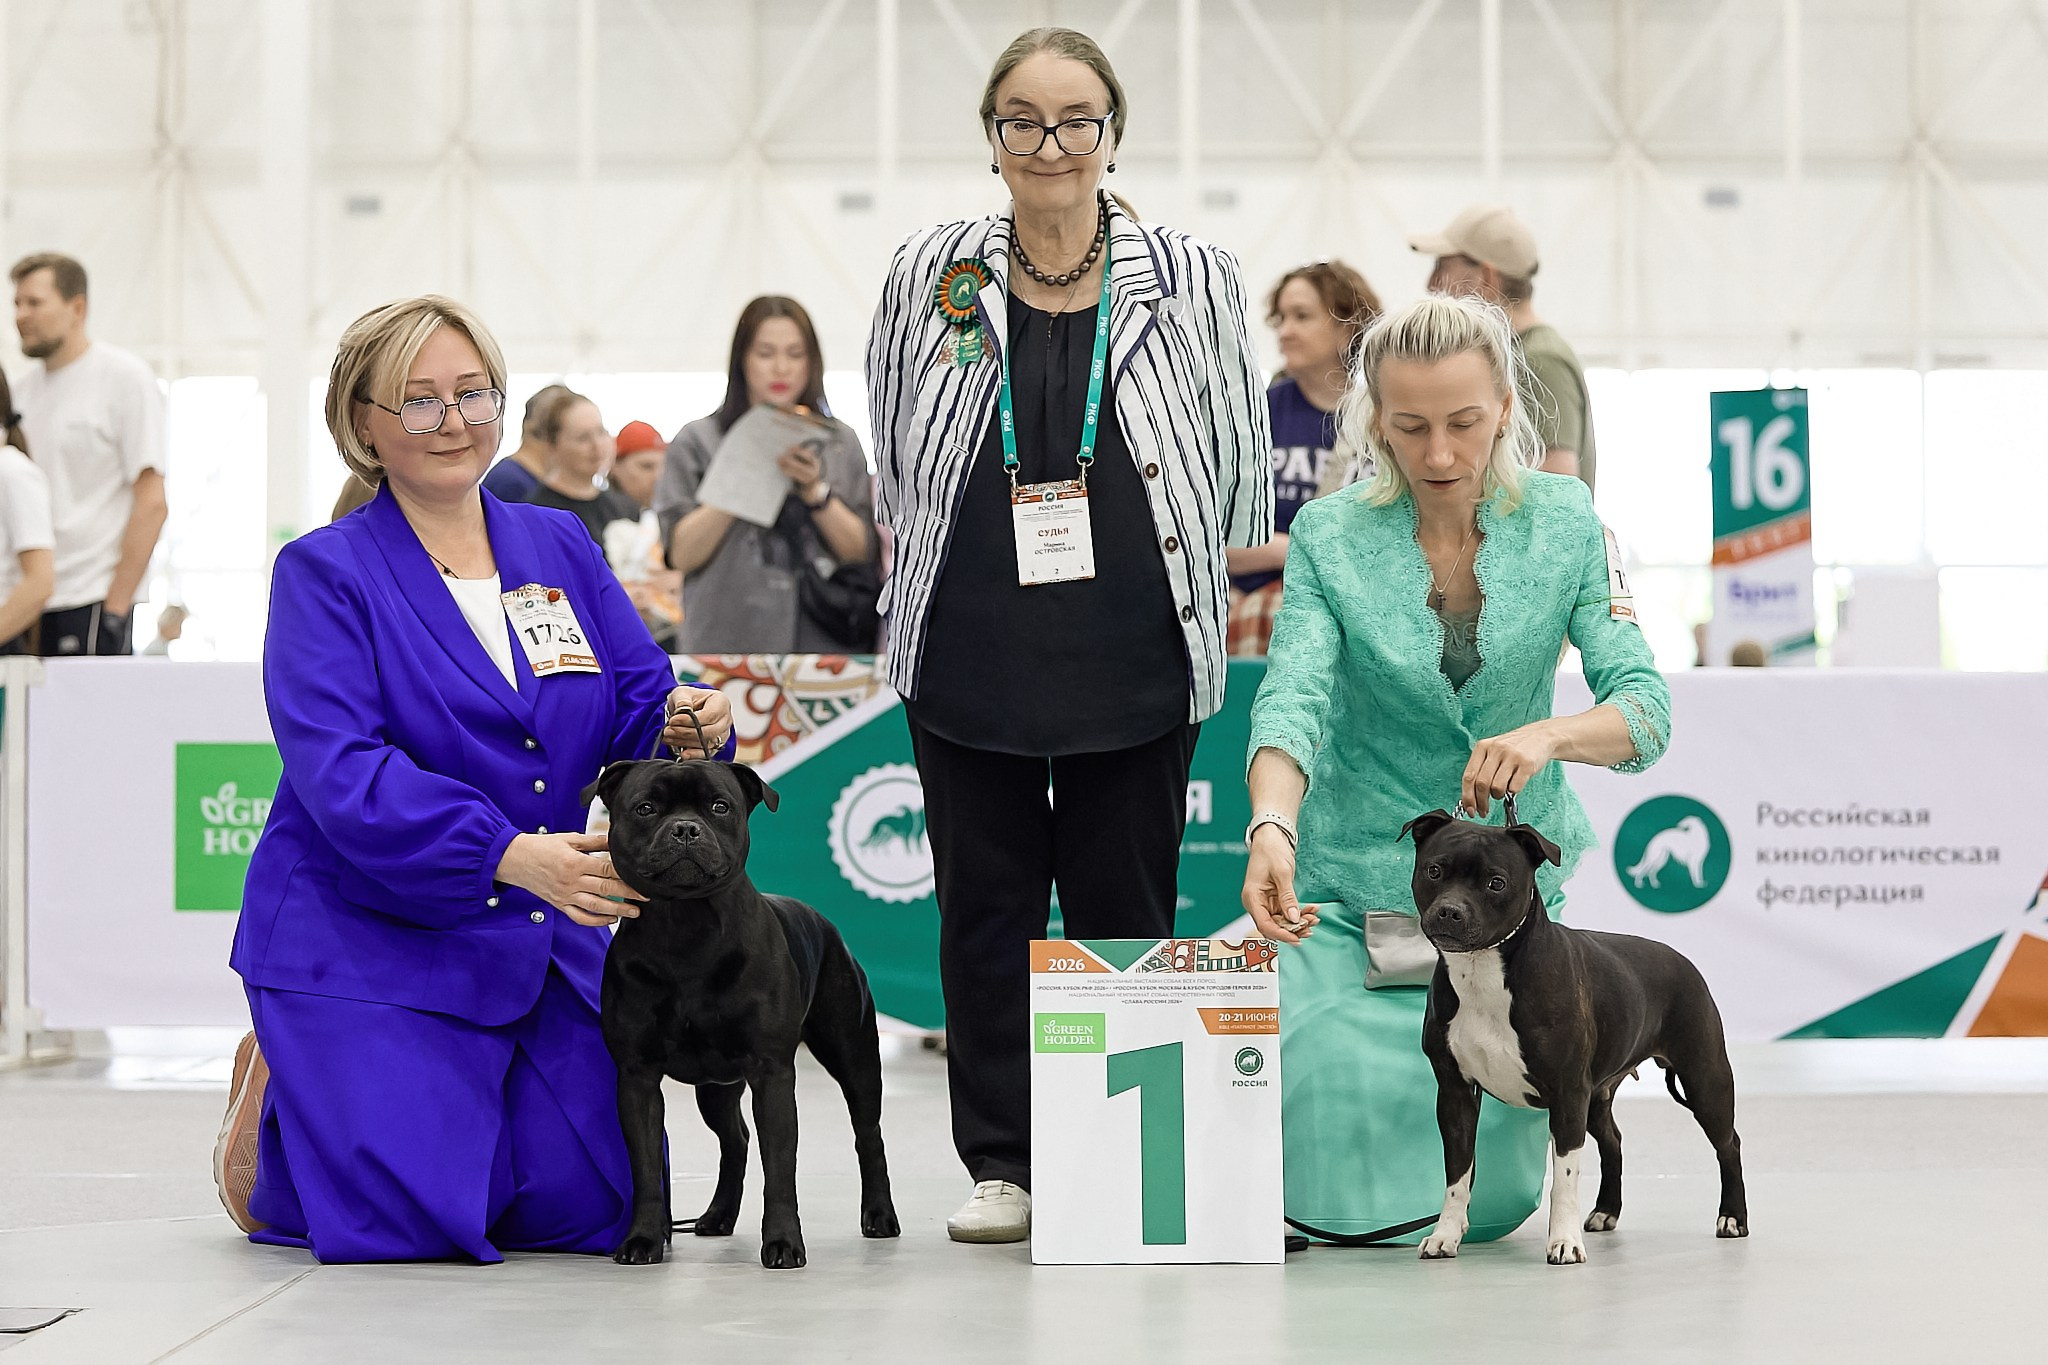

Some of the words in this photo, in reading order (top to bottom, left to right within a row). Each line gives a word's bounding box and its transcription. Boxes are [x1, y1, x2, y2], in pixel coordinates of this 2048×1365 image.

[1099, 316, 1108, 337] РКФ
[1093, 359, 1103, 380] РКФ
[1002, 409, 1012, 432] РКФ
[1087, 402, 1098, 425] РКФ
[1717, 415, 1805, 511] 16
[1037, 527, 1069, 537] СУДЬЯ
[524, 624, 581, 645] 1726
[1756, 801, 1931, 827] Российская
[203, 827, 262, 855] HO
[1756, 846, 2000, 865] кинологическая
[1757, 878, 1925, 909] федерация
[1047, 958, 1086, 971] 2026
[1218, 1013, 1244, 1022] 20-21
[1245, 1012, 1277, 1022] ИЮНЯ
[1044, 1035, 1096, 1045] HOLDER
[1051, 1025, 1094, 1035] GREEN
[1106, 1041, 1187, 1246] 1
